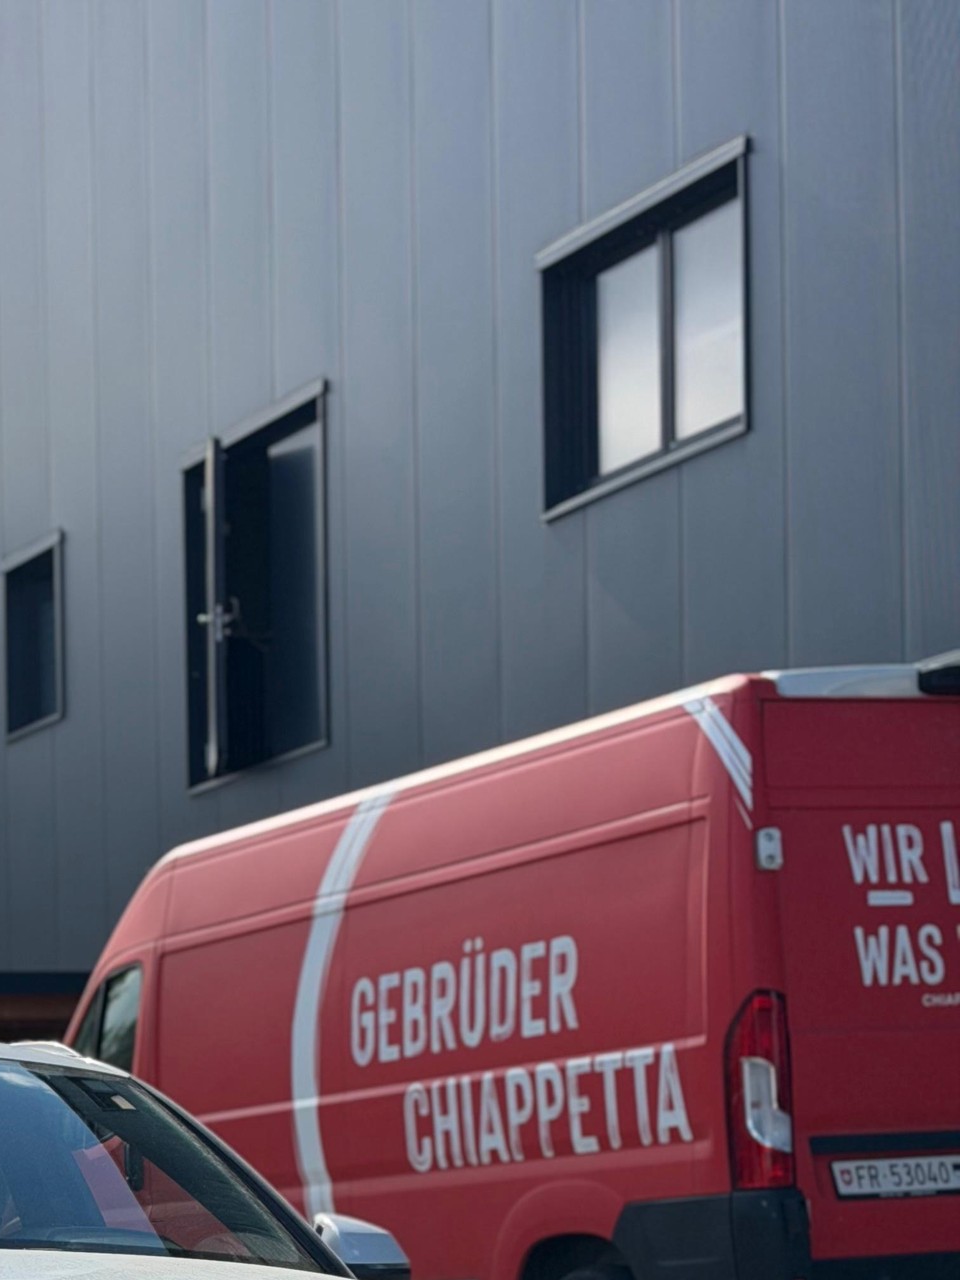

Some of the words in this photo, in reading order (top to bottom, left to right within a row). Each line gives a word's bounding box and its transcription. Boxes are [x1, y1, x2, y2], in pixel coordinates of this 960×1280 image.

[842, 823, 929, 885] WIR
[351, 935, 579, 1067] GEBRÜDER
[853, 923, 945, 987] WAS
[403, 1043, 693, 1173] CHIAPPETTA
